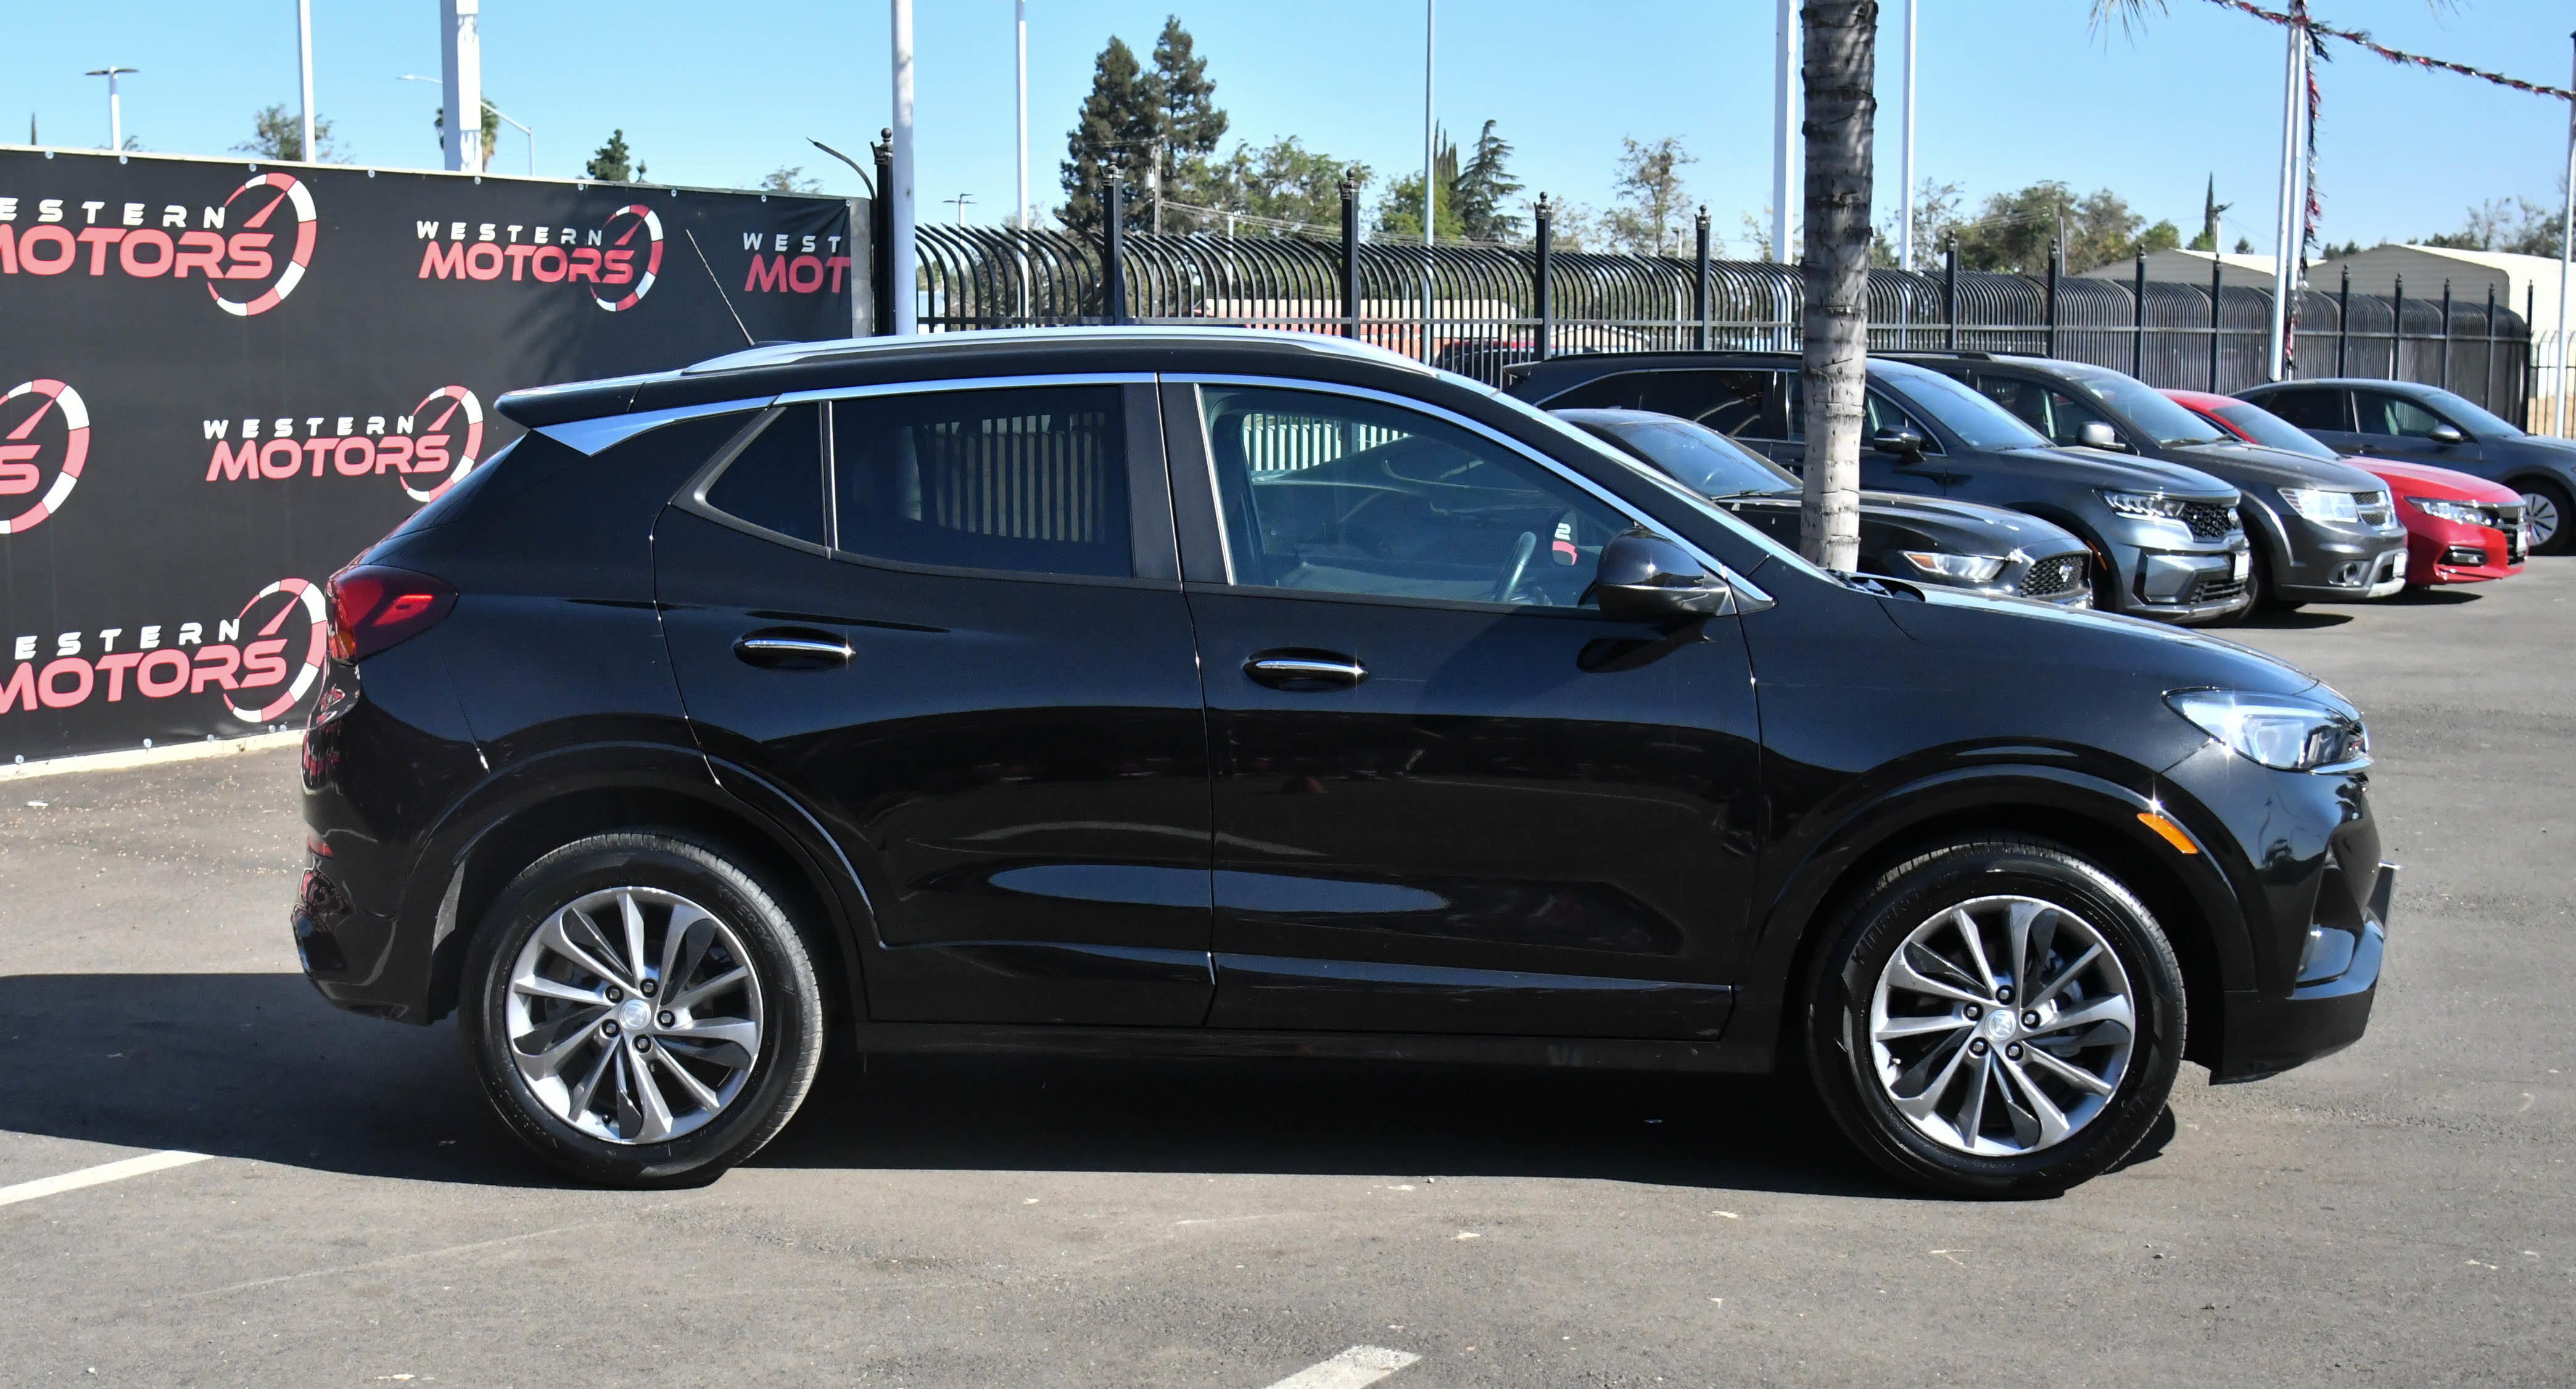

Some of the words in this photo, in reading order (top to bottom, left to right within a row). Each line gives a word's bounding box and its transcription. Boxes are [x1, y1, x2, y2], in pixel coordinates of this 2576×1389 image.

[0, 223, 275, 280] OTORS
[417, 220, 602, 247] WESTERN
[743, 232, 841, 253] WEST
[418, 241, 635, 284] MOTORS
[745, 254, 851, 294] MOT
[204, 416, 415, 440] WESTERN
[205, 434, 451, 482] MOTORS
